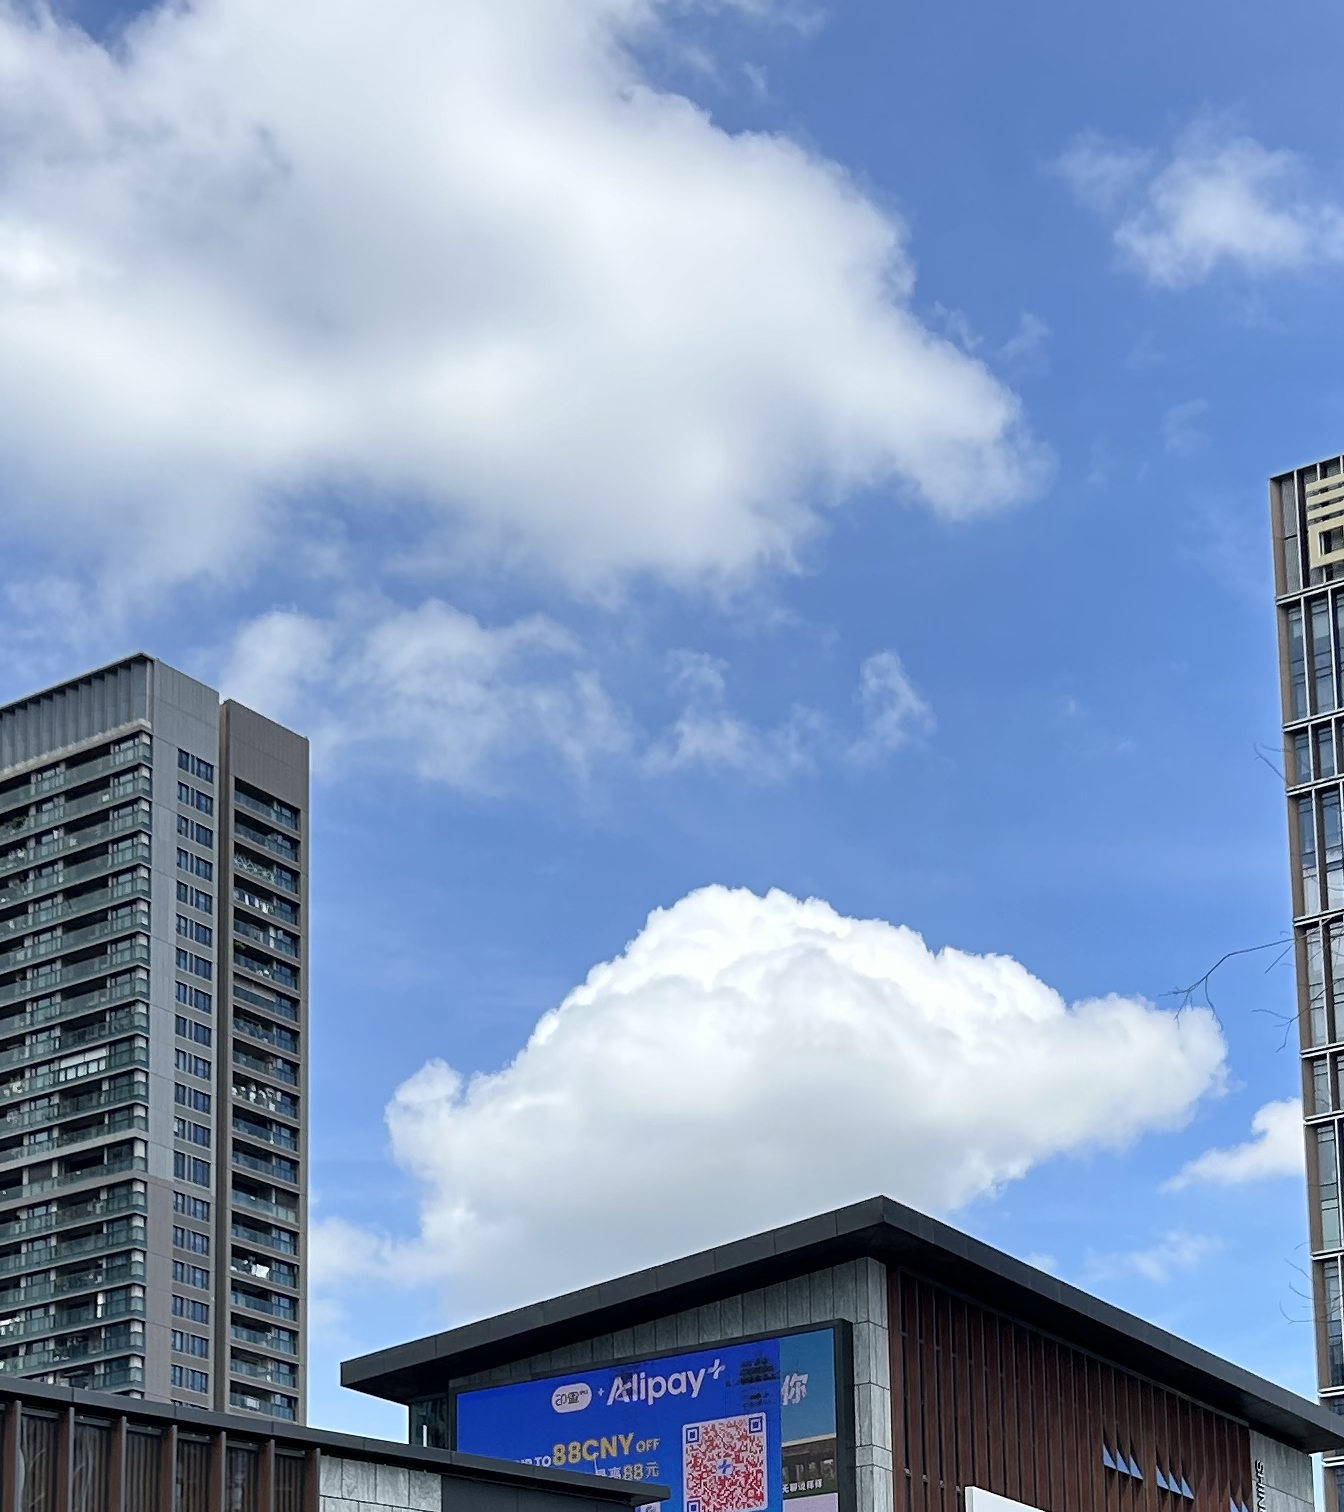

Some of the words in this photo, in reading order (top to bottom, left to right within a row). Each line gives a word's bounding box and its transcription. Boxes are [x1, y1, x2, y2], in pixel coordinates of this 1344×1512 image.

[781, 1372, 809, 1407] 你
[552, 1432, 635, 1467] 88CNY
[636, 1438, 661, 1454] OFF
